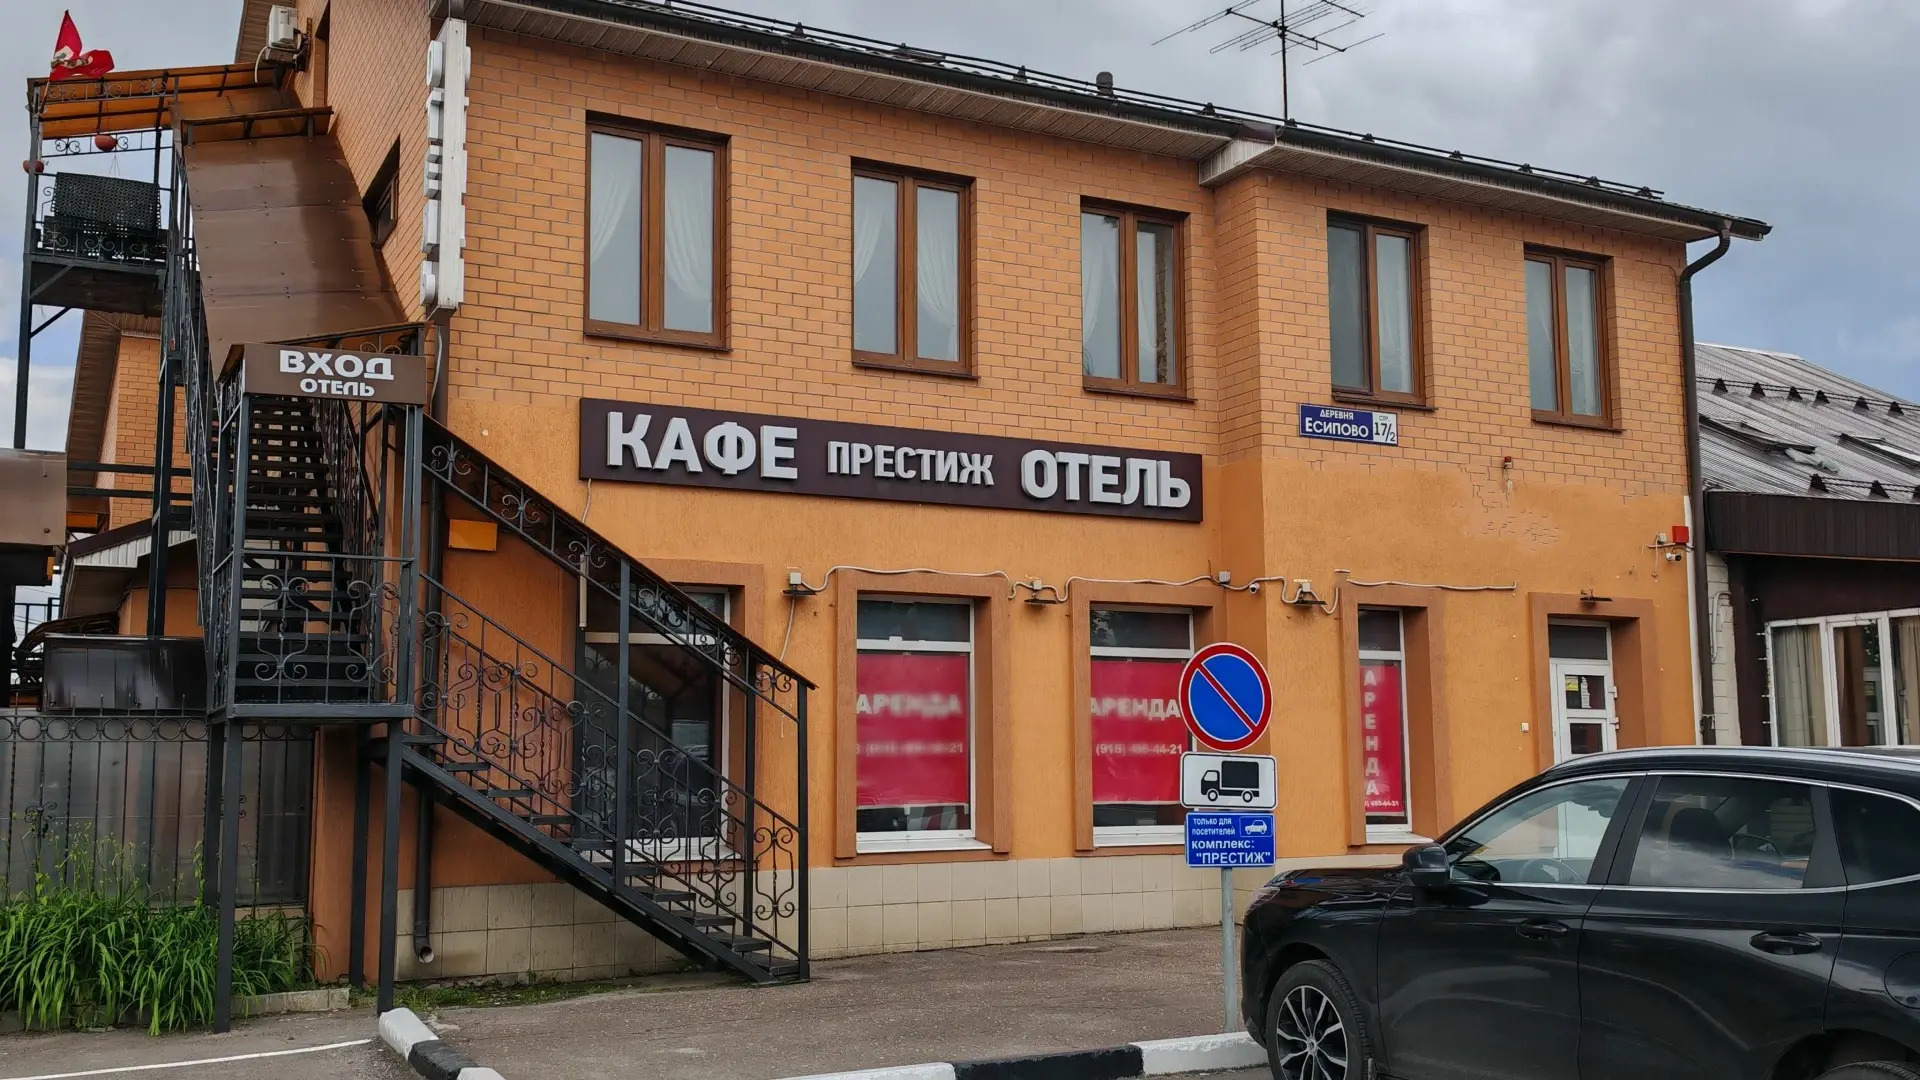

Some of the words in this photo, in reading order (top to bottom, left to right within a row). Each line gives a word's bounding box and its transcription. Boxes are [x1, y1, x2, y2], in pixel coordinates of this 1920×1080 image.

[279, 349, 394, 380] ВХОД
[300, 378, 375, 397] ОТЕЛЬ
[1319, 409, 1354, 421] ДЕРЕВНЯ
[606, 411, 798, 479] КАФЕ
[827, 441, 994, 486] ПРЕСТИЖ
[1020, 449, 1191, 508] ОТЕЛЬ
[1090, 697, 1181, 721] АРЕНДА
[1364, 669, 1379, 796] АРЕНДА
[1196, 851, 1271, 864] "ПРЕСТИЖ"
